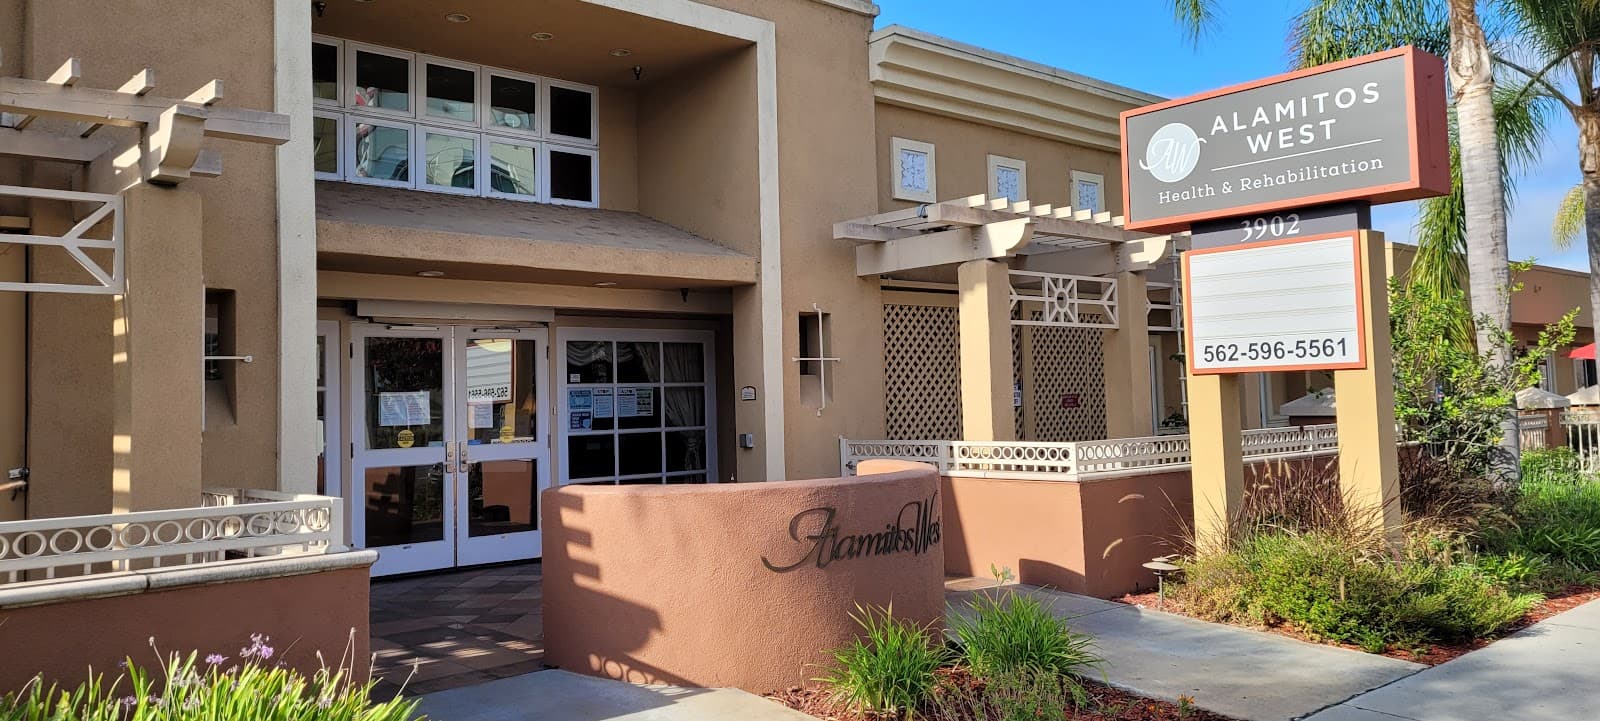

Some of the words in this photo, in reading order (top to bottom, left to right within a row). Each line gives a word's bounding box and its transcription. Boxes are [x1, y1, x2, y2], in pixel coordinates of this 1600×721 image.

[1210, 82, 1380, 135] ALAMITOS
[1246, 118, 1336, 154] WEST
[1158, 183, 1216, 204] Health
[1222, 181, 1233, 194] &
[1239, 157, 1384, 192] Rehabilitation
[1240, 213, 1301, 242] 3902
[1203, 337, 1348, 363] 562-596-5561
[760, 506, 915, 574] Alamitos
